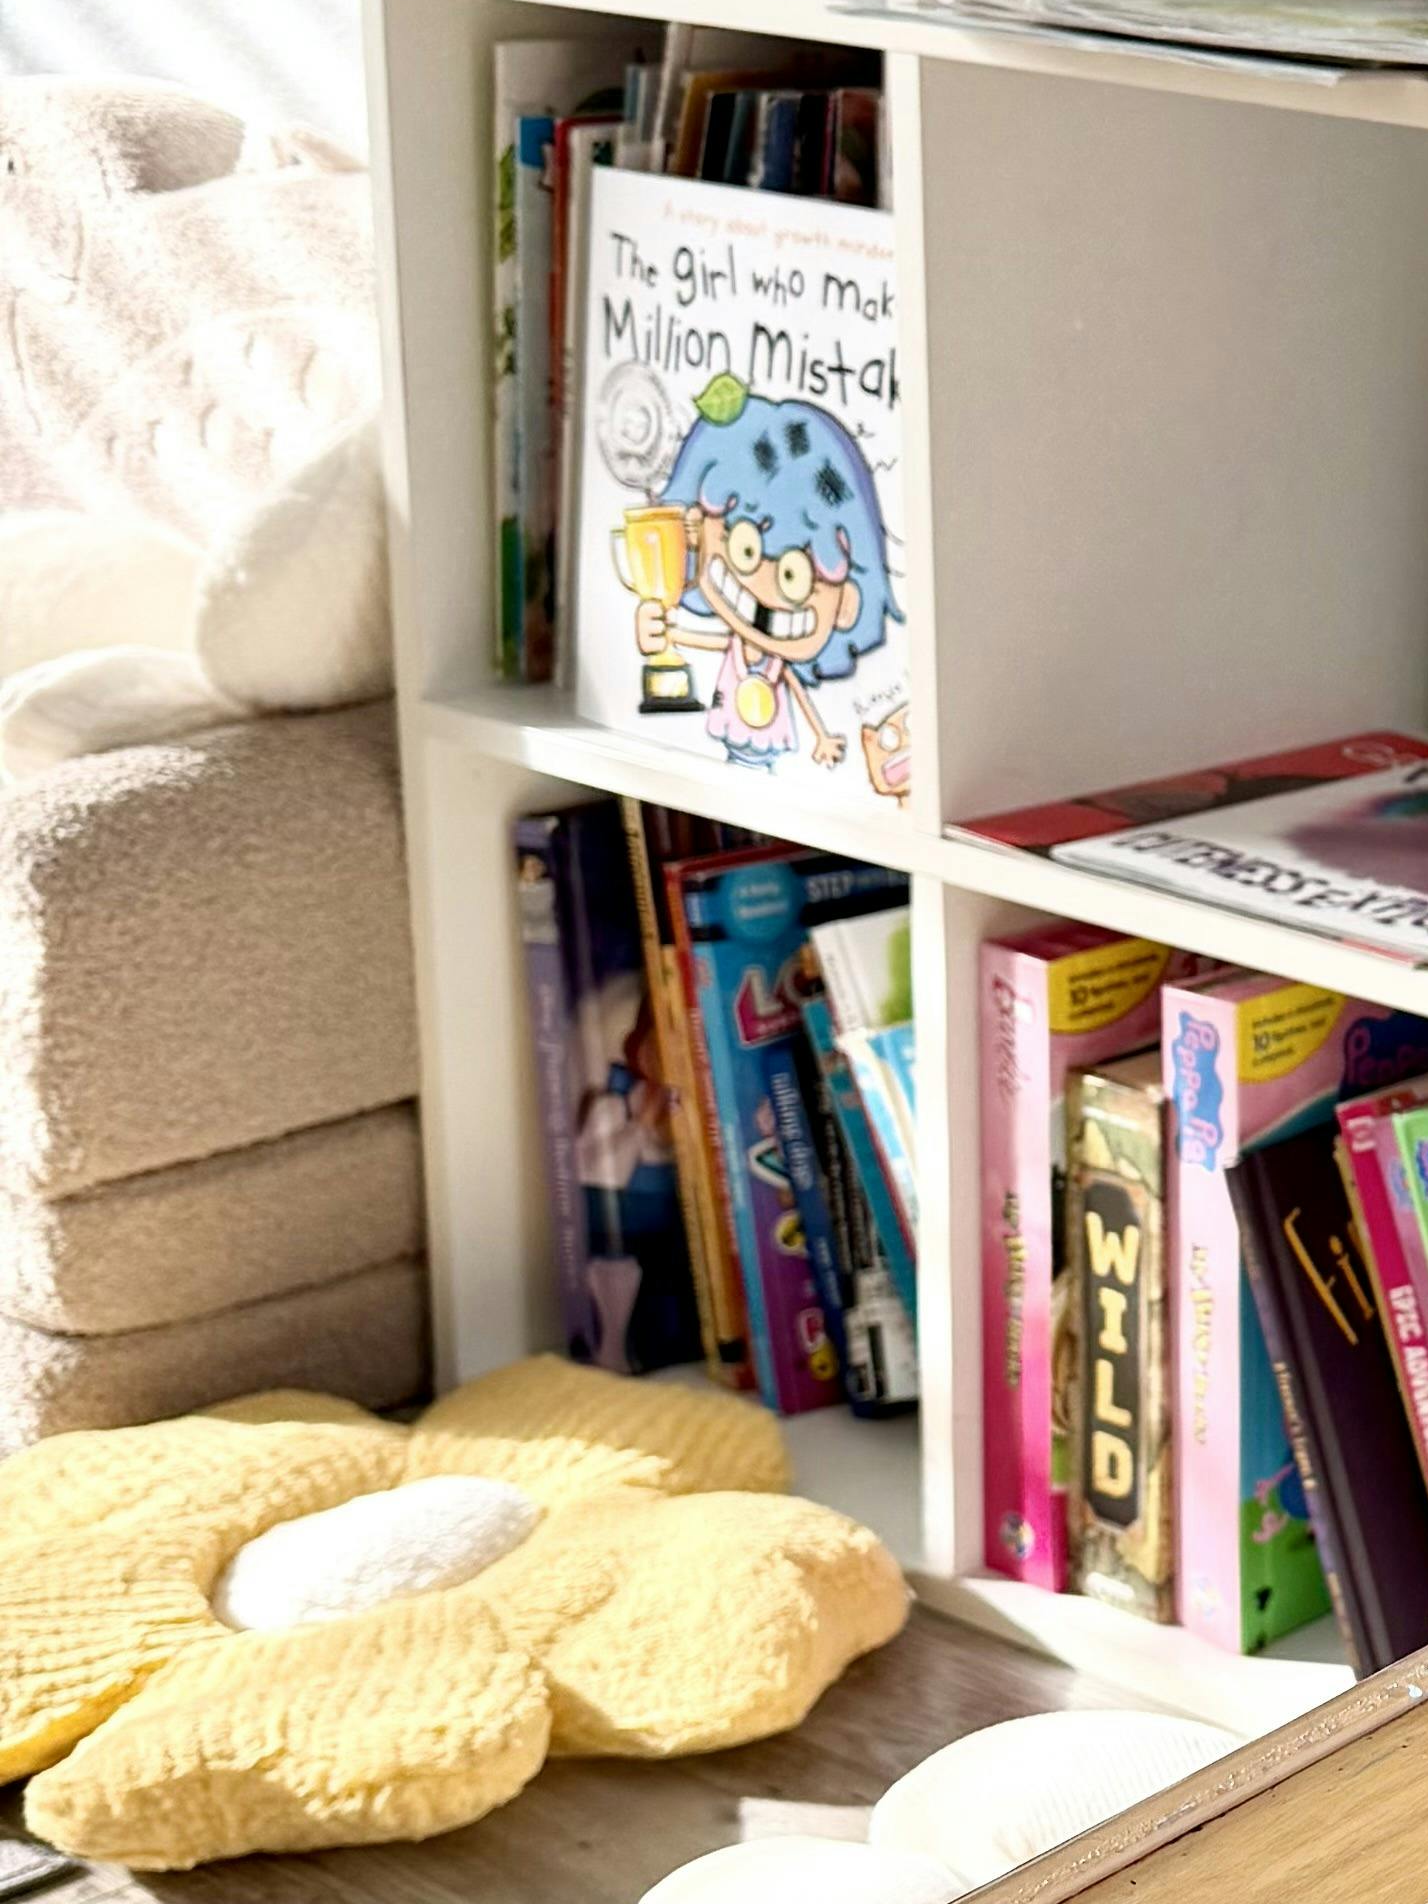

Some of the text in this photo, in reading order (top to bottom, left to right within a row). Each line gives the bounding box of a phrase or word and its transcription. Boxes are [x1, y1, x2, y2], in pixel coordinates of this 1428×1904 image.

[610, 231, 659, 288] The
[672, 242, 737, 308] girl
[751, 264, 806, 307] who
[602, 292, 732, 374] Million
[1389, 1283, 1424, 1344] EPIC
[1085, 1211, 1142, 1501] WILD
